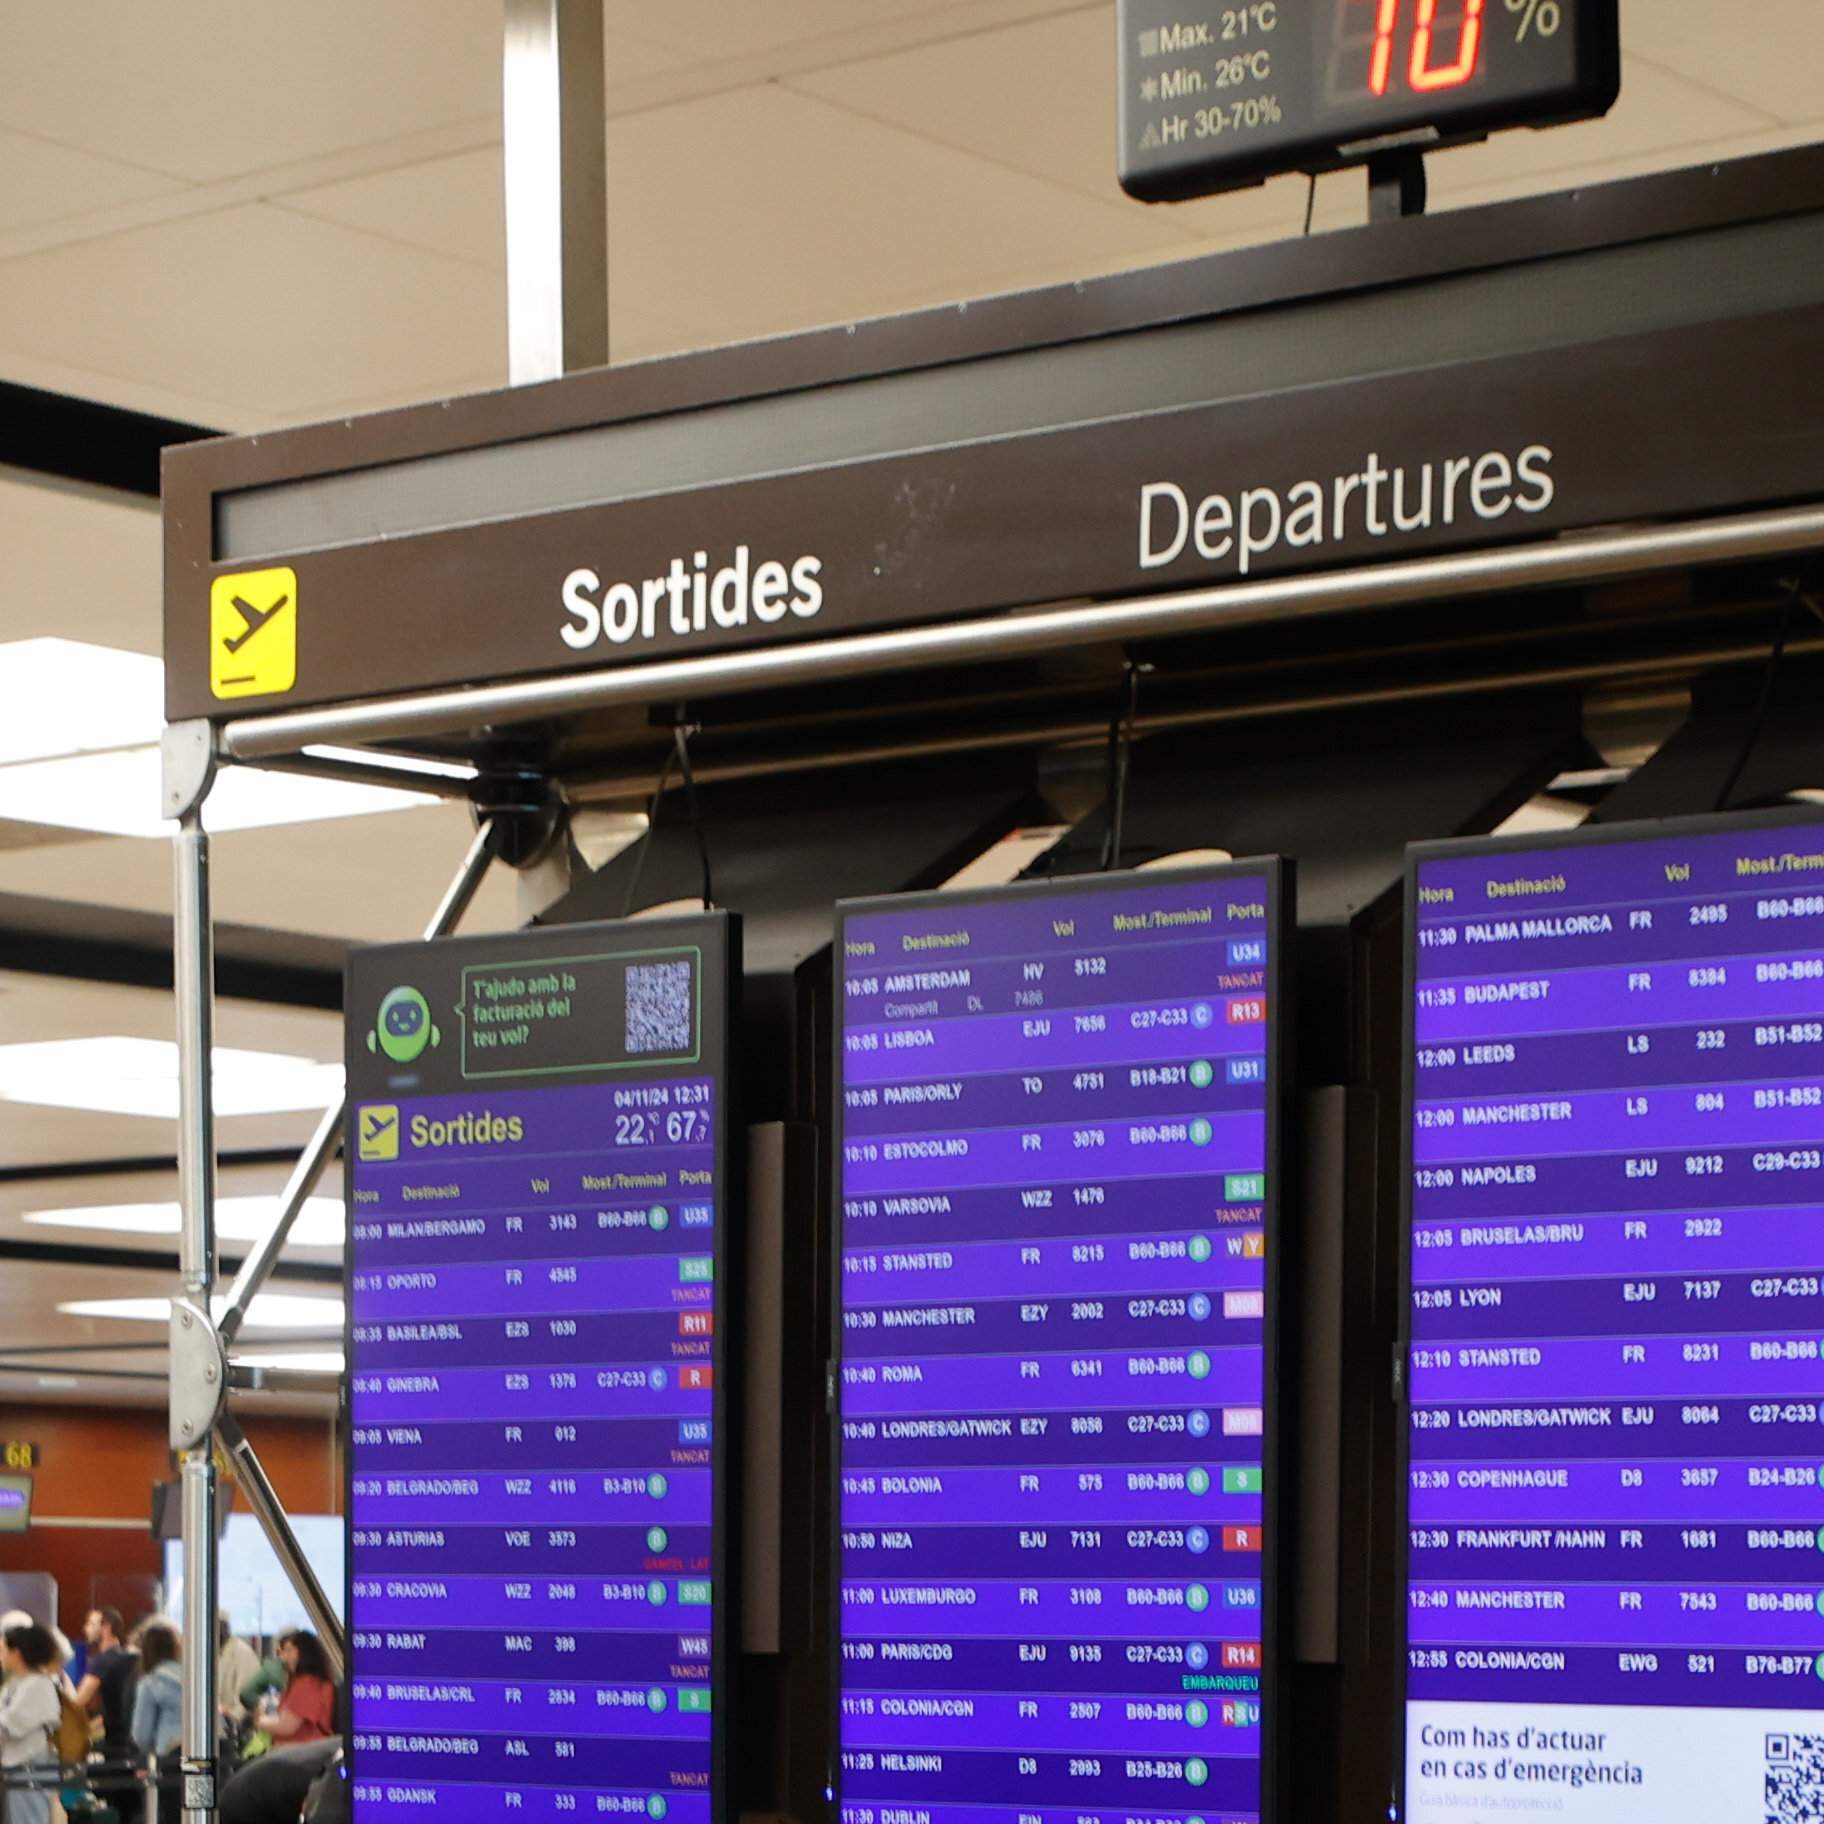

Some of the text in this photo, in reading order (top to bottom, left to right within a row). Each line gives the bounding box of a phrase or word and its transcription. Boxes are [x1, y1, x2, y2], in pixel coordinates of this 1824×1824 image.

[1160, 2, 1276, 54] Max. 21°C
[1161, 51, 1269, 100] Min. 26°C
[1162, 96, 1281, 144] Hr 30-70%
[1140, 446, 1558, 577] Departures
[560, 546, 828, 655] Sortides
[1419, 888, 1453, 903] Hora
[1487, 875, 1565, 898] Destinació
[1665, 864, 1689, 881] Vol
[1227, 904, 1264, 920] Porta
[1419, 911, 1651, 946] 11:30 PALMA MALLORCA FR
[885, 944, 1260, 993] AMSTERDAM U34
[528, 974, 559, 994] amb
[563, 973, 576, 991] la
[1465, 973, 1650, 1003] BUDAPEST FR
[473, 997, 570, 1023] facturació del
[500, 1025, 529, 1045] vol?
[885, 1003, 1259, 1048] LISBOA EJU R13
[1417, 1045, 1515, 1067] 12:00 LEEDS
[884, 1061, 1258, 1104] PARIS/ORLY U31
[1416, 1102, 1571, 1127] 12:00 MANCHESTER
[411, 1111, 523, 1147] Sortides
[884, 1139, 968, 1160] ESTOCOLMO
[1462, 1159, 1657, 1185] NAPOLES EJU
[883, 1196, 950, 1215] VARSOVIA
[1461, 1224, 1583, 1245] BRUSELAS/BRU
[883, 1252, 952, 1271] STANSTED
[1460, 1278, 1818, 1306] LYON 7137 C27-C33
[883, 1308, 975, 1326] MANCHESTER
[1413, 1348, 1540, 1368] 12:10 STANSTED
[882, 1366, 922, 1382] ROMA
[1412, 1408, 1611, 1428] 12:20 LONDRES/GATWICK
[882, 1420, 1011, 1438] LONDRES/GATWICK
[6, 1440, 31, 1470] 68
[882, 1477, 942, 1493] BOLONIA
[1412, 1470, 1568, 1488] 12:30 COPENHAGUE
[882, 1533, 912, 1548] NIZA
[1457, 1530, 1605, 1547] FRANKFURT /HAHN
[882, 1588, 975, 1604] LUXEMBURGO
[1410, 1591, 1448, 1607] 12:40
[1456, 1591, 1564, 1608] MANCHESTER
[881, 1644, 1255, 1663] PARIS/CDG R14
[1456, 1651, 1564, 1669] COLONIA/CGN
[1619, 1654, 1657, 1671] EWG
[1183, 1675, 1258, 1690] EMBARQUEU
[1422, 1725, 1605, 1750] Com has d'actuar
[881, 1755, 941, 1771] HELSINKI
[1421, 1758, 1642, 1786] en cas d'emergència
